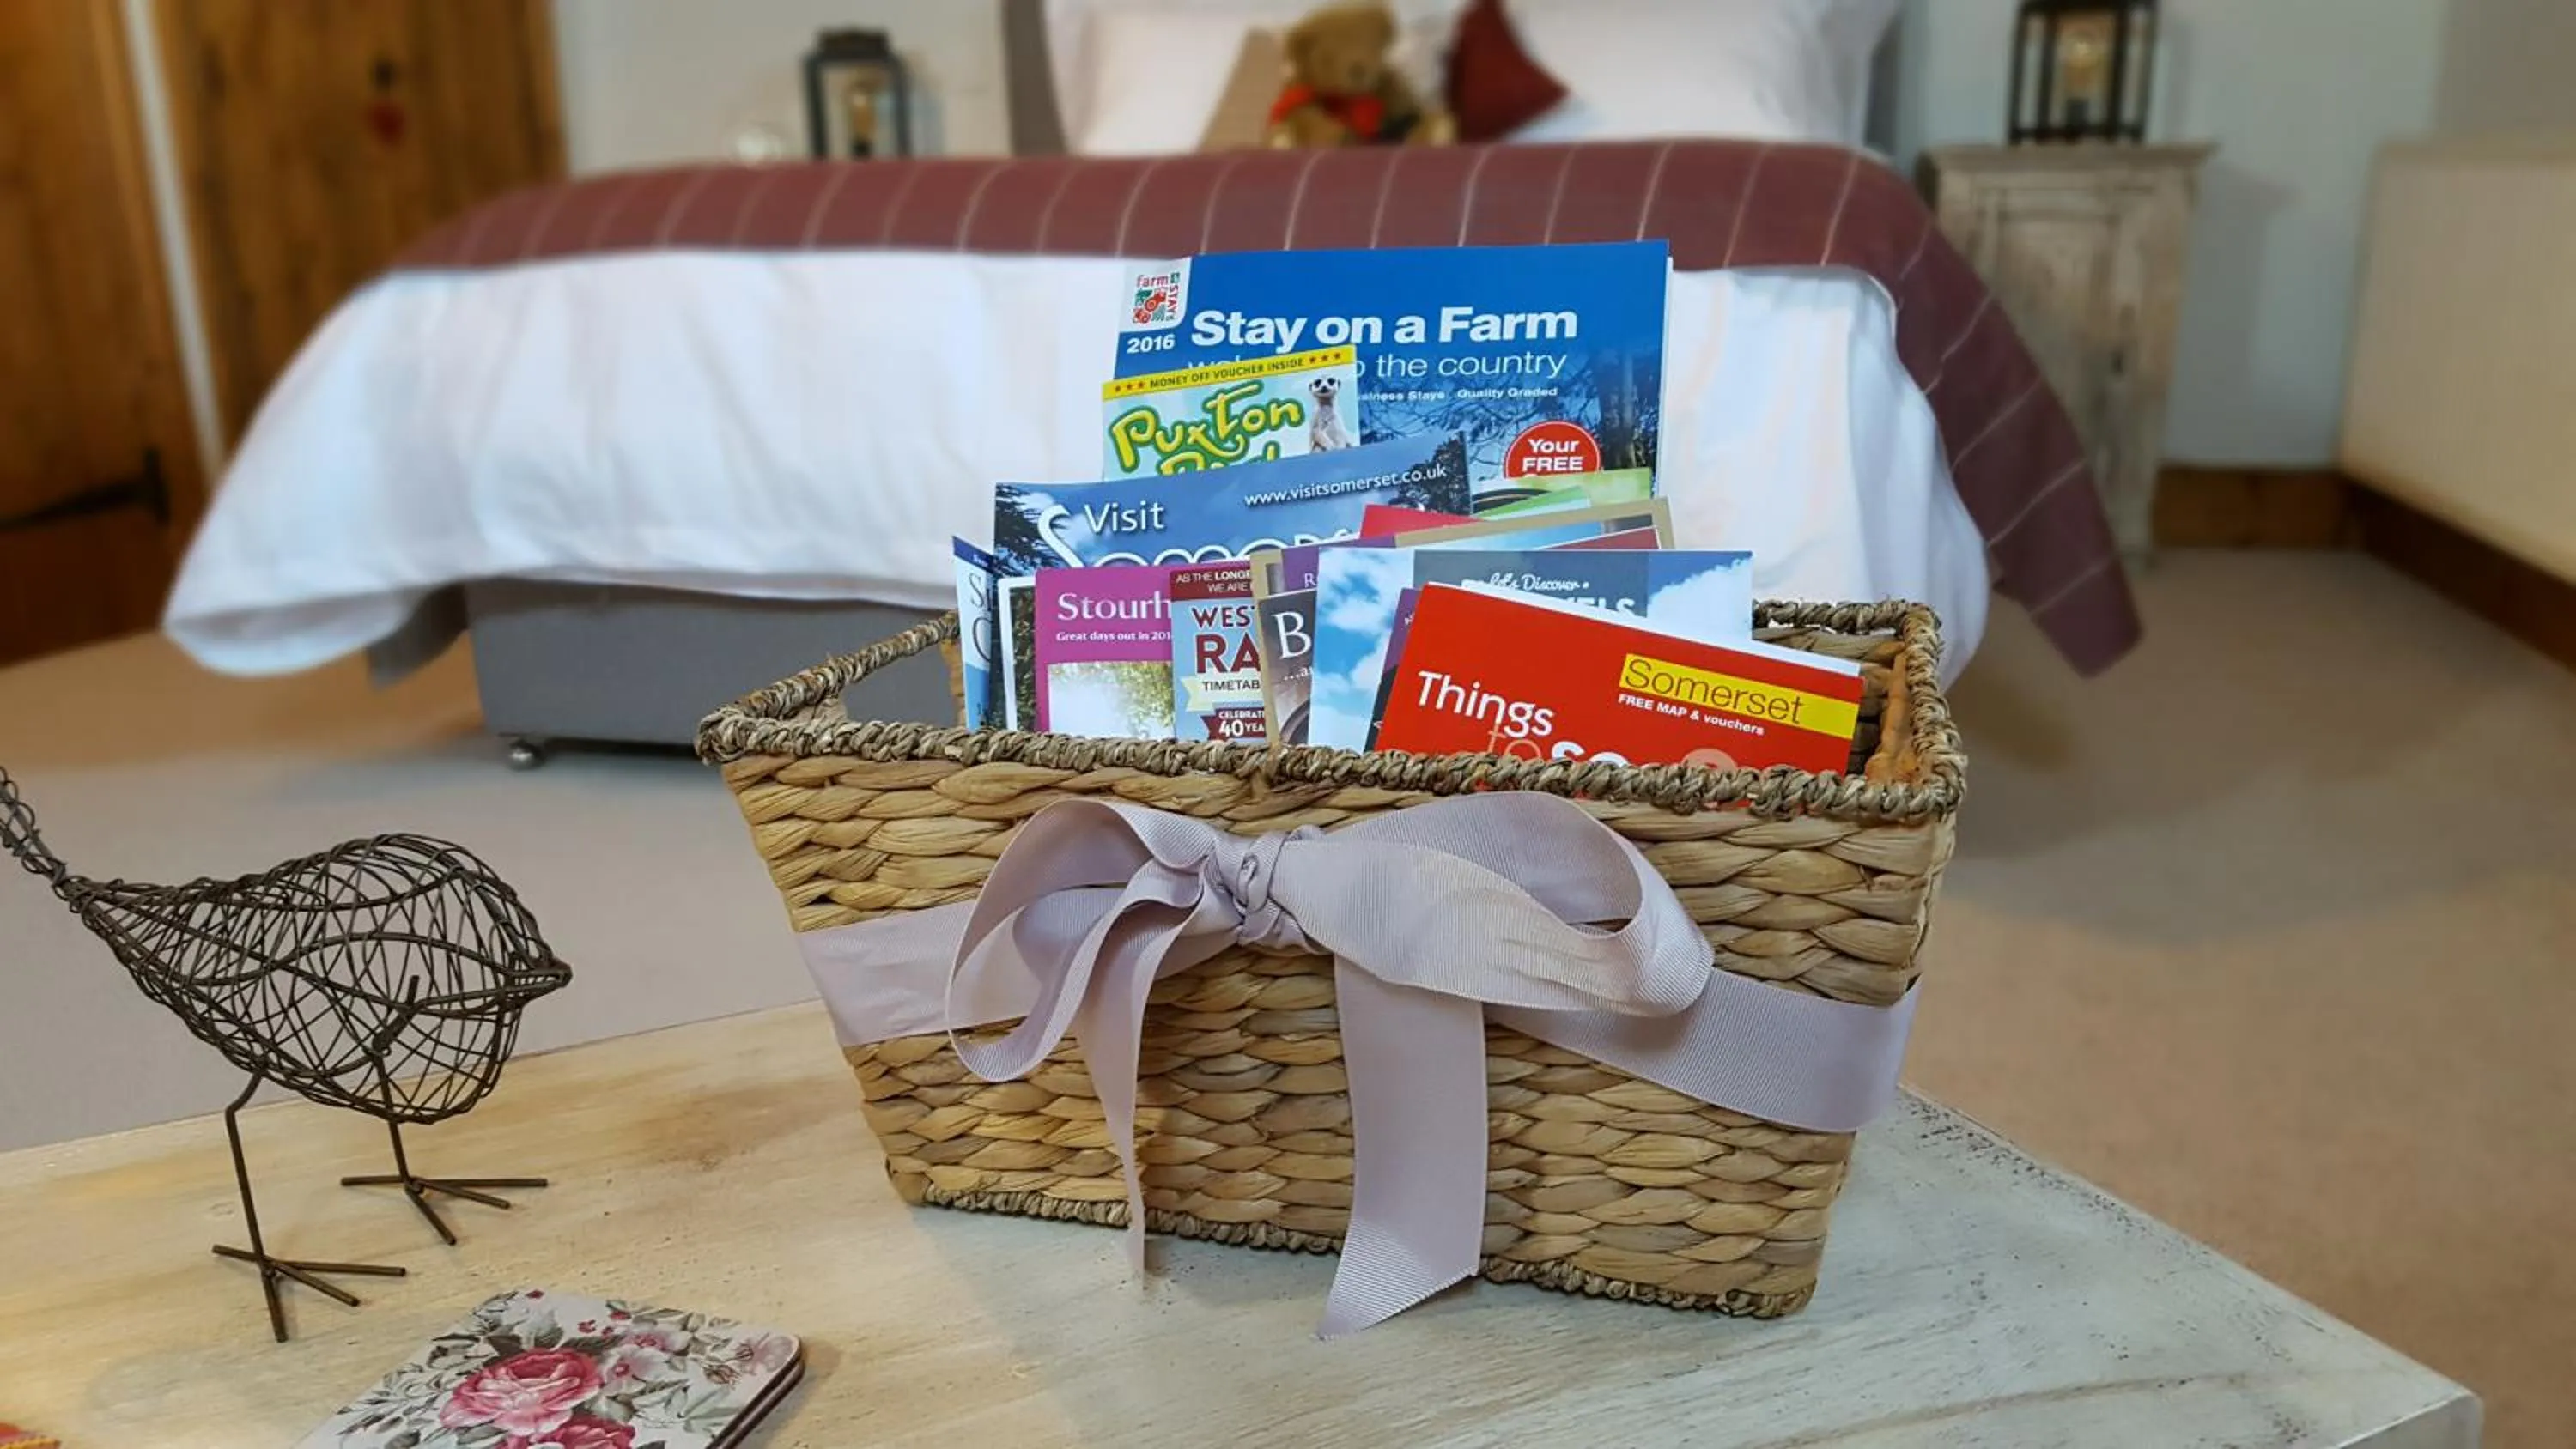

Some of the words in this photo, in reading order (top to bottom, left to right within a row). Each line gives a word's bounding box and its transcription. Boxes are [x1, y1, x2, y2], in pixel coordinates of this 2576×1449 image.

[1137, 275, 1168, 287] farm
[1191, 310, 1306, 354] Stay
[1315, 315, 1383, 344] on
[1394, 317, 1425, 343] a
[1438, 306, 1578, 343] Farm
[1126, 333, 1176, 354] 2016
[1150, 375, 1188, 388] MONEY
[1192, 371, 1209, 383] OFF
[1213, 363, 1264, 379] VOUCHER
[1267, 357, 1303, 372] INSIDE
[1376, 353, 1428, 378] the
[1438, 351, 1567, 379] country
[1458, 387, 1503, 400] Quality
[1508, 386, 1558, 397] Graded
[1109, 380, 1304, 471] Puxton
[1528, 439, 1580, 453] Your
[1522, 456, 1583, 472] FREE
[1245, 464, 1447, 506] www.visitsomerset.co.uk
[1083, 500, 1165, 533] Visit
[1176, 573, 1191, 583] AS
[1193, 572, 1213, 582] THE
[1207, 583, 1225, 592] WE
[1227, 582, 1249, 592] ARE
[1521, 573, 1581, 591] Discover
[1192, 605, 1255, 628] WES
[1055, 631, 1087, 641] Great
[1090, 631, 1115, 643] days
[1117, 632, 1136, 641] out
[1138, 631, 1150, 641] in
[1202, 679, 1260, 691] TIMETAB
[1625, 658, 1806, 725] Somerset
[1418, 670, 1555, 738] Things
[1618, 694, 1654, 711] FREE
[1656, 700, 1687, 718] MAP
[1690, 710, 1700, 722] &
[1704, 713, 1765, 736] vouchers
[1218, 718, 1244, 737] 40
